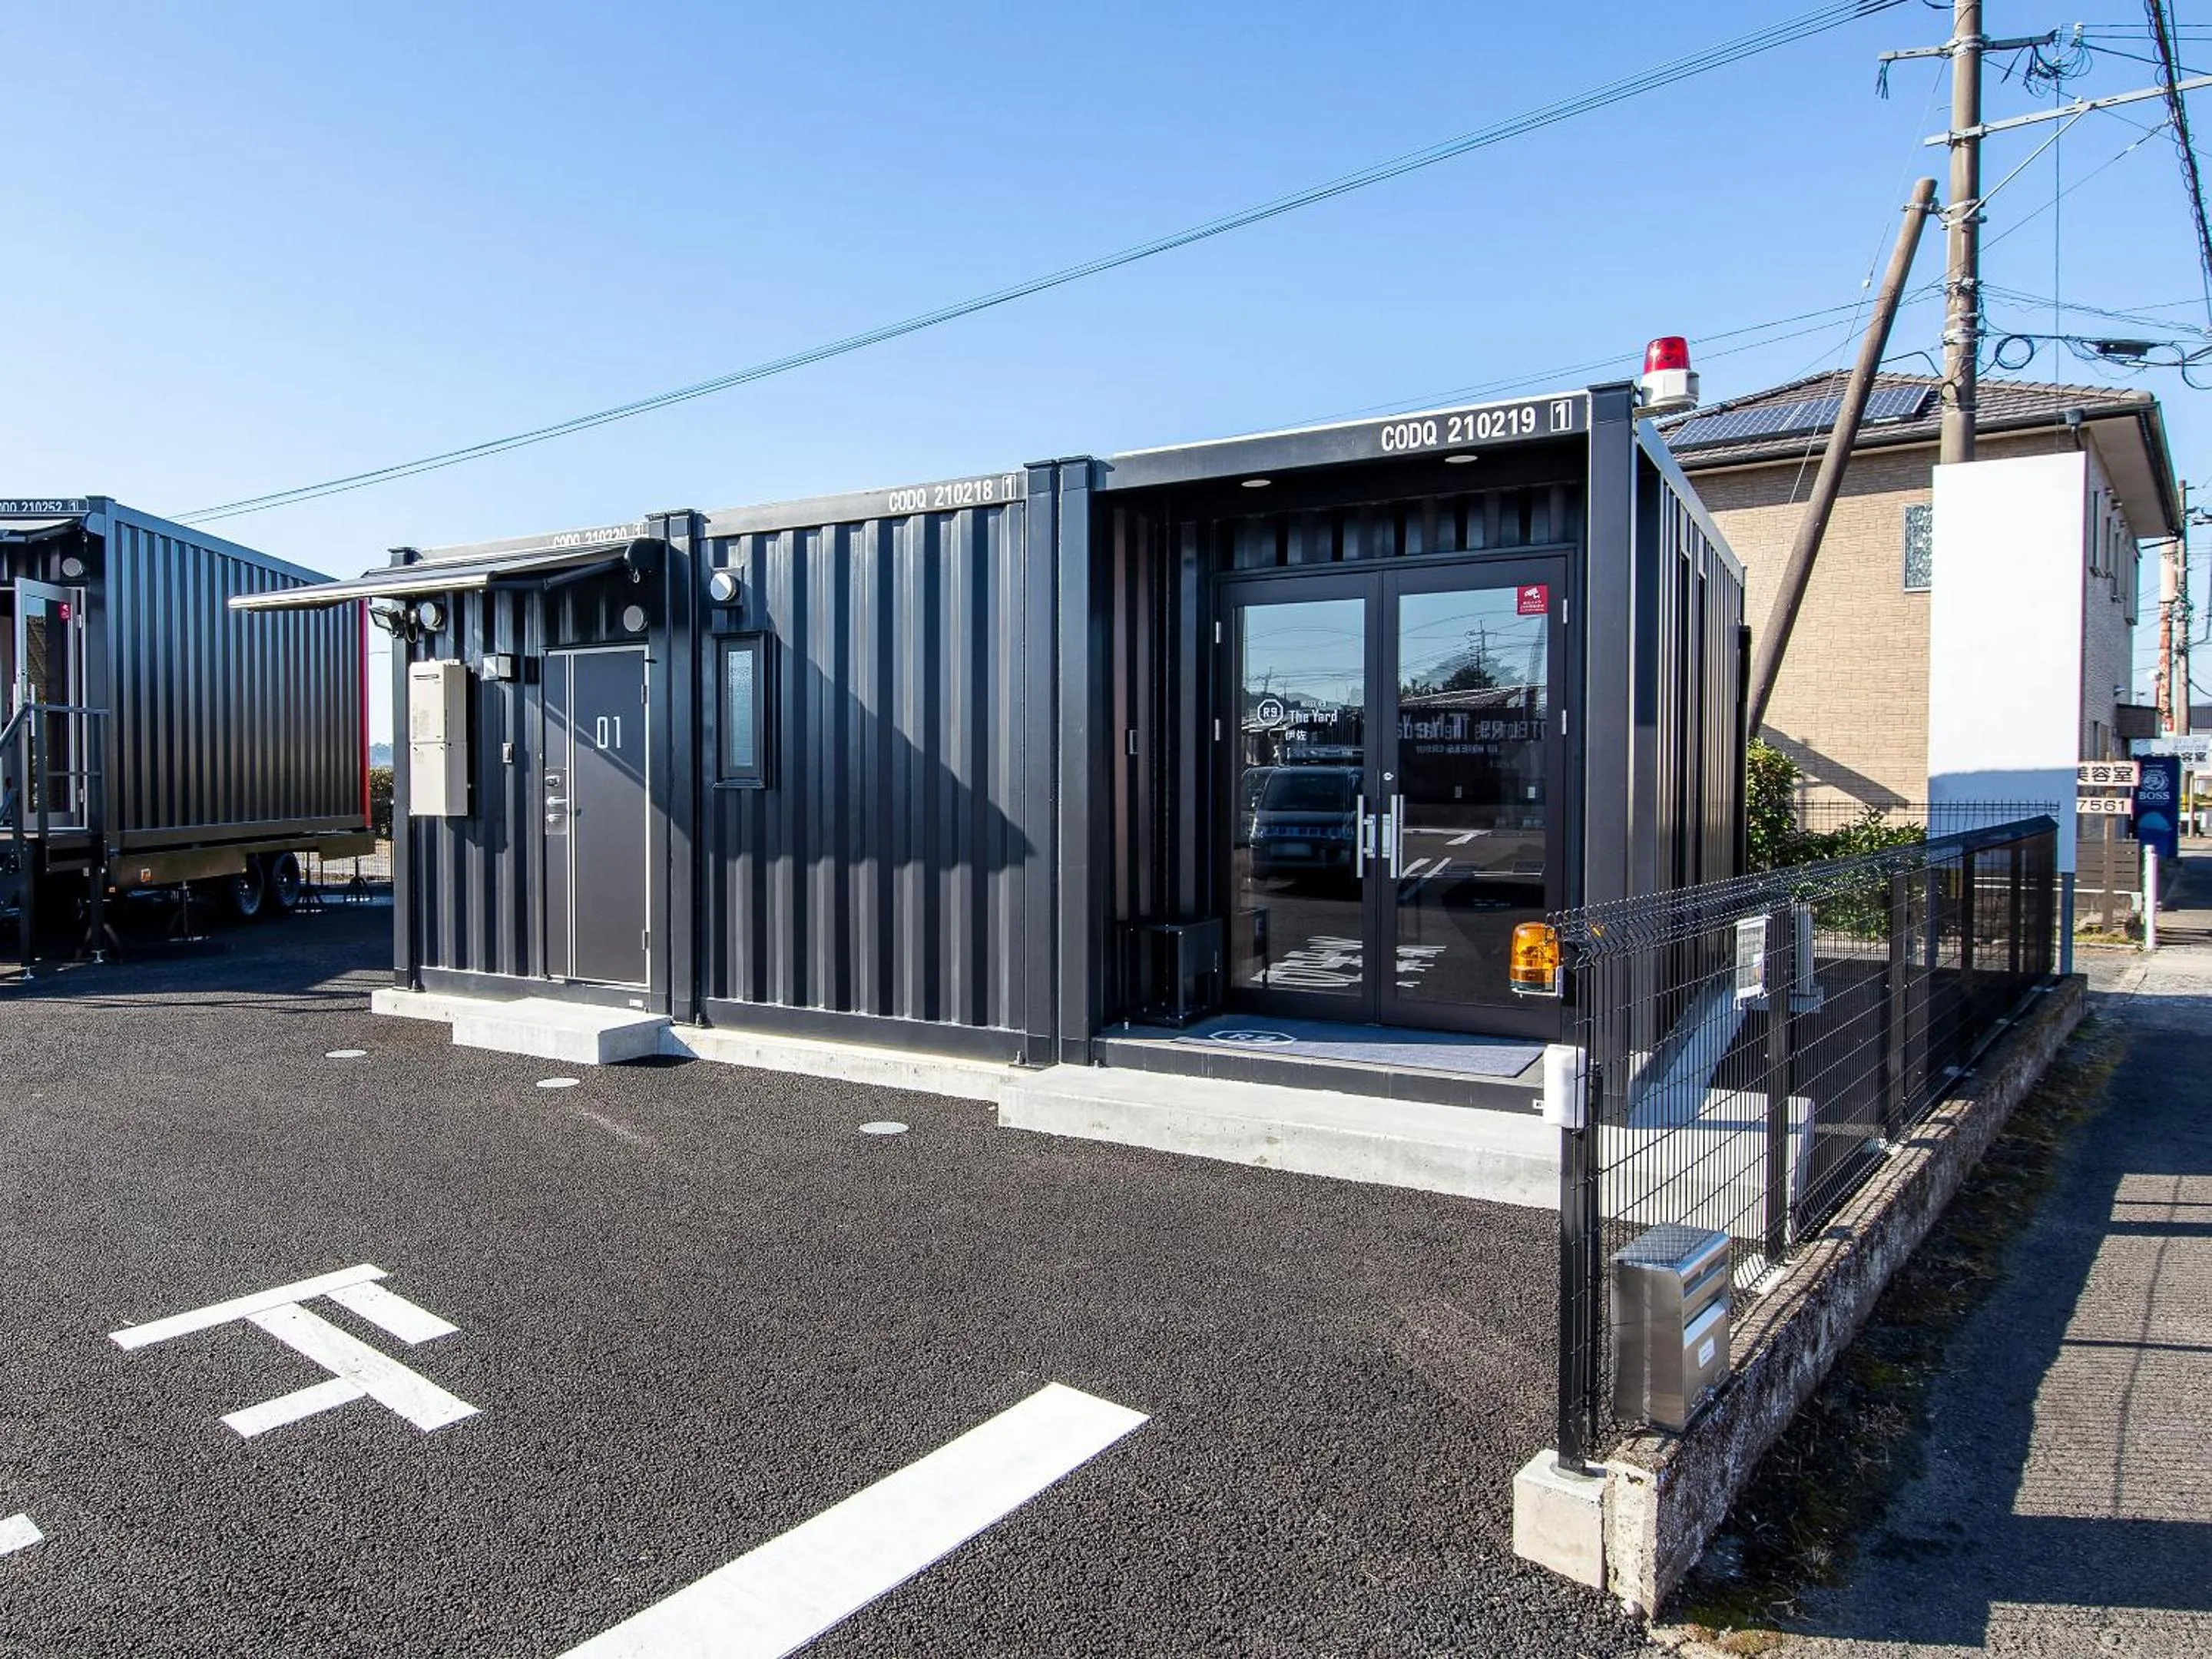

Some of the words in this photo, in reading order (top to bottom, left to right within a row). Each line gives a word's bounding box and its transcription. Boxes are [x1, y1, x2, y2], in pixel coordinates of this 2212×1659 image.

[1381, 420, 1437, 452] CODQ
[1447, 406, 1535, 443] 210219
[889, 488, 926, 512] CODQ
[935, 478, 993, 507] 210218
[1263, 707, 1278, 718] R9
[1289, 710, 1309, 723] The
[1311, 709, 1338, 723] Yard
[597, 716, 621, 749] 01
[2137, 791, 2171, 800] BOSS
